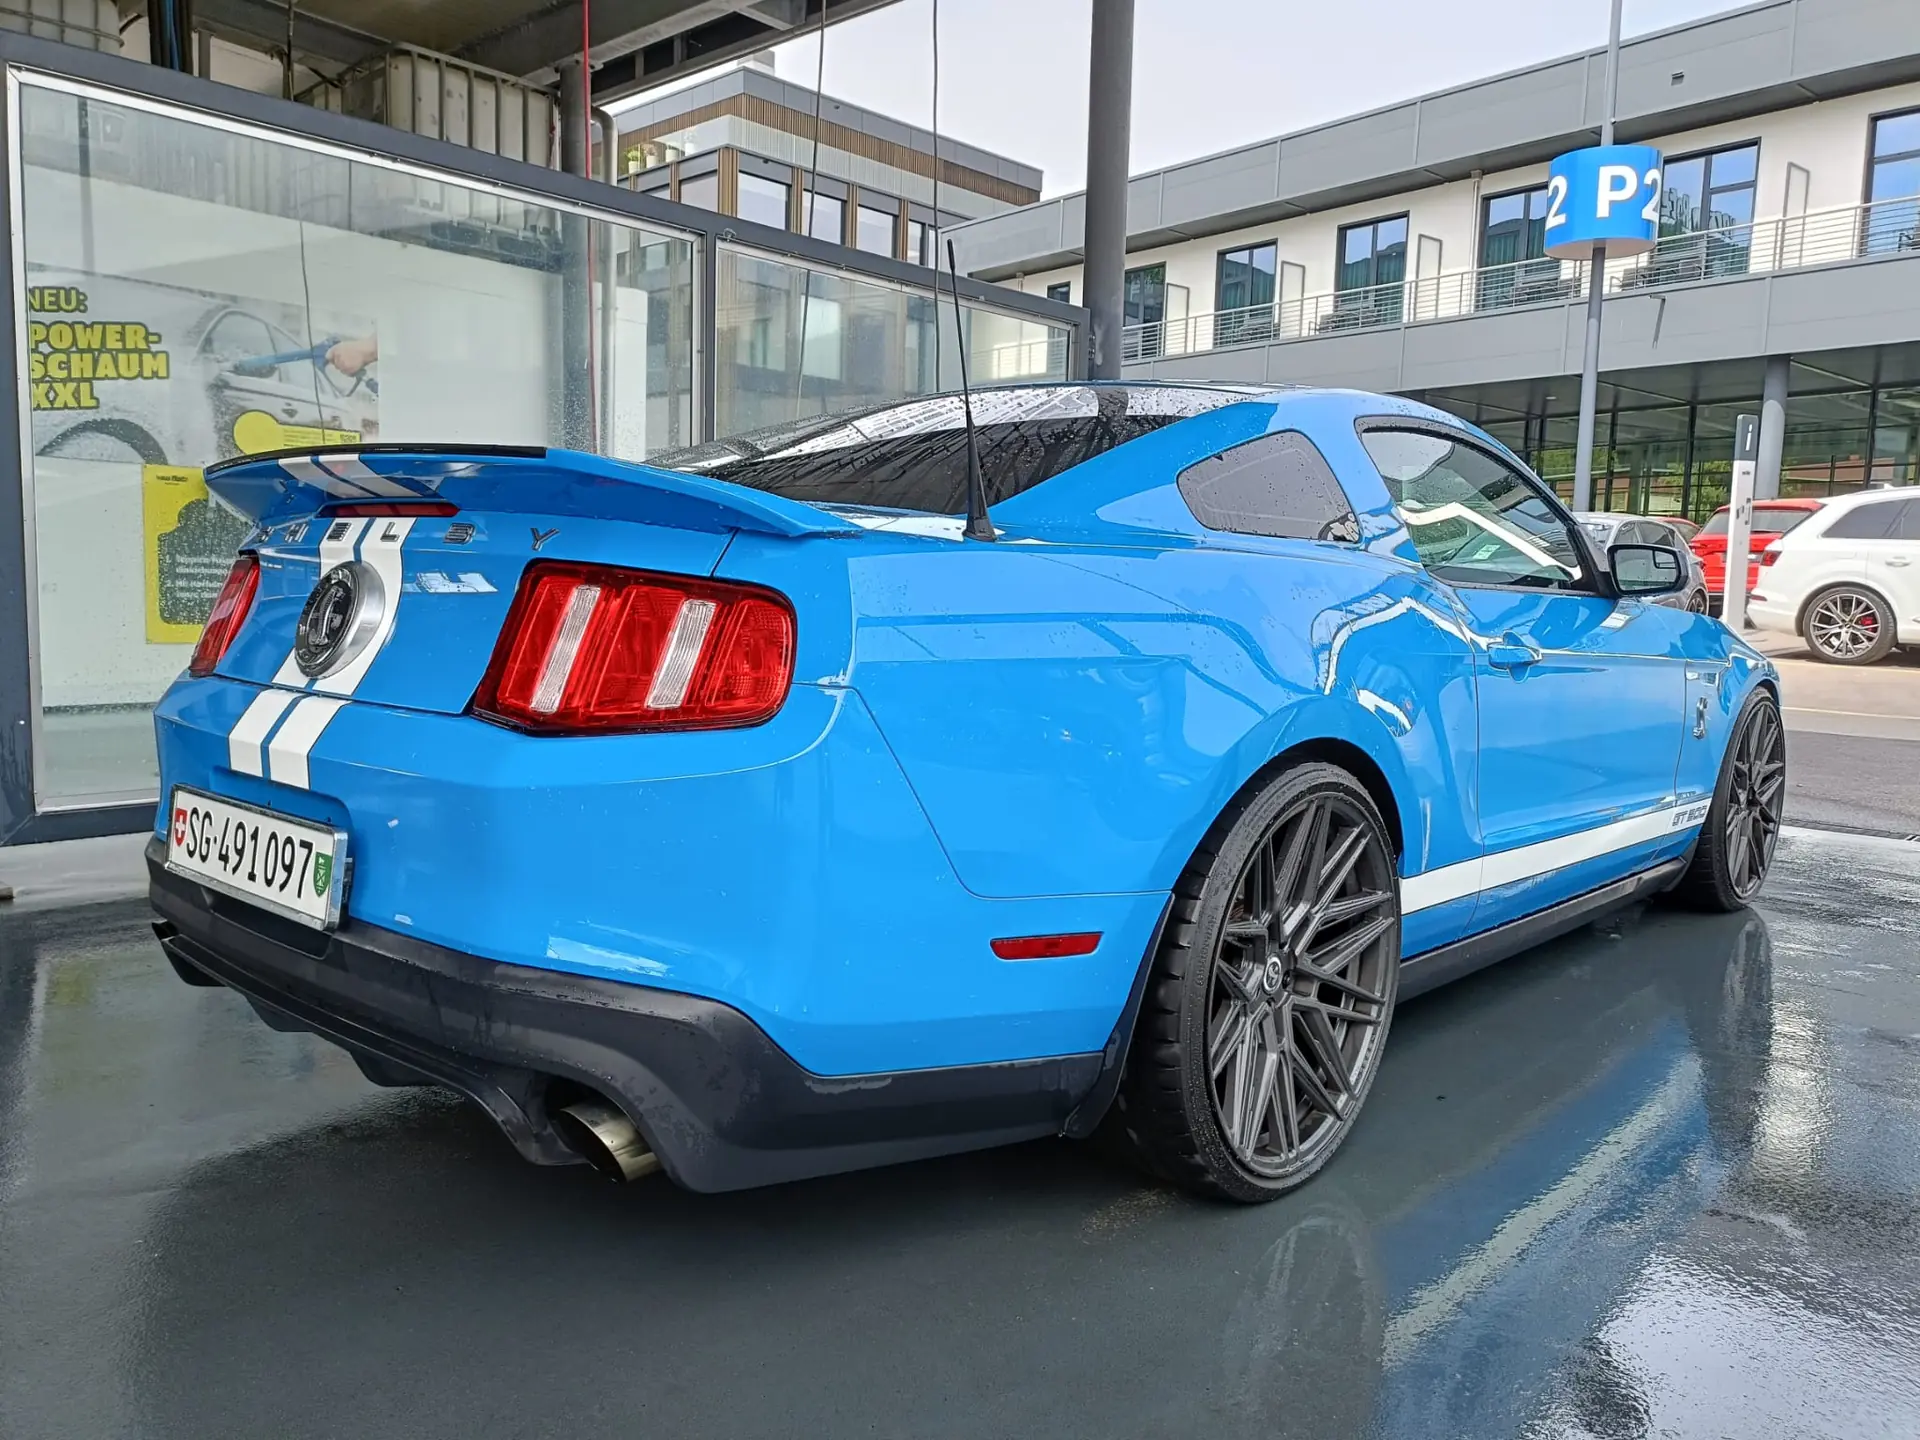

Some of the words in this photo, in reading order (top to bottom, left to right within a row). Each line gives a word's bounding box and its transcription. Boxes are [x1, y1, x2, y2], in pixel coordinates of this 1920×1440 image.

[29, 287, 87, 313] NEU:
[30, 321, 162, 351] POWER-
[31, 351, 169, 379] SCHAUM
[32, 381, 99, 410] XXL
